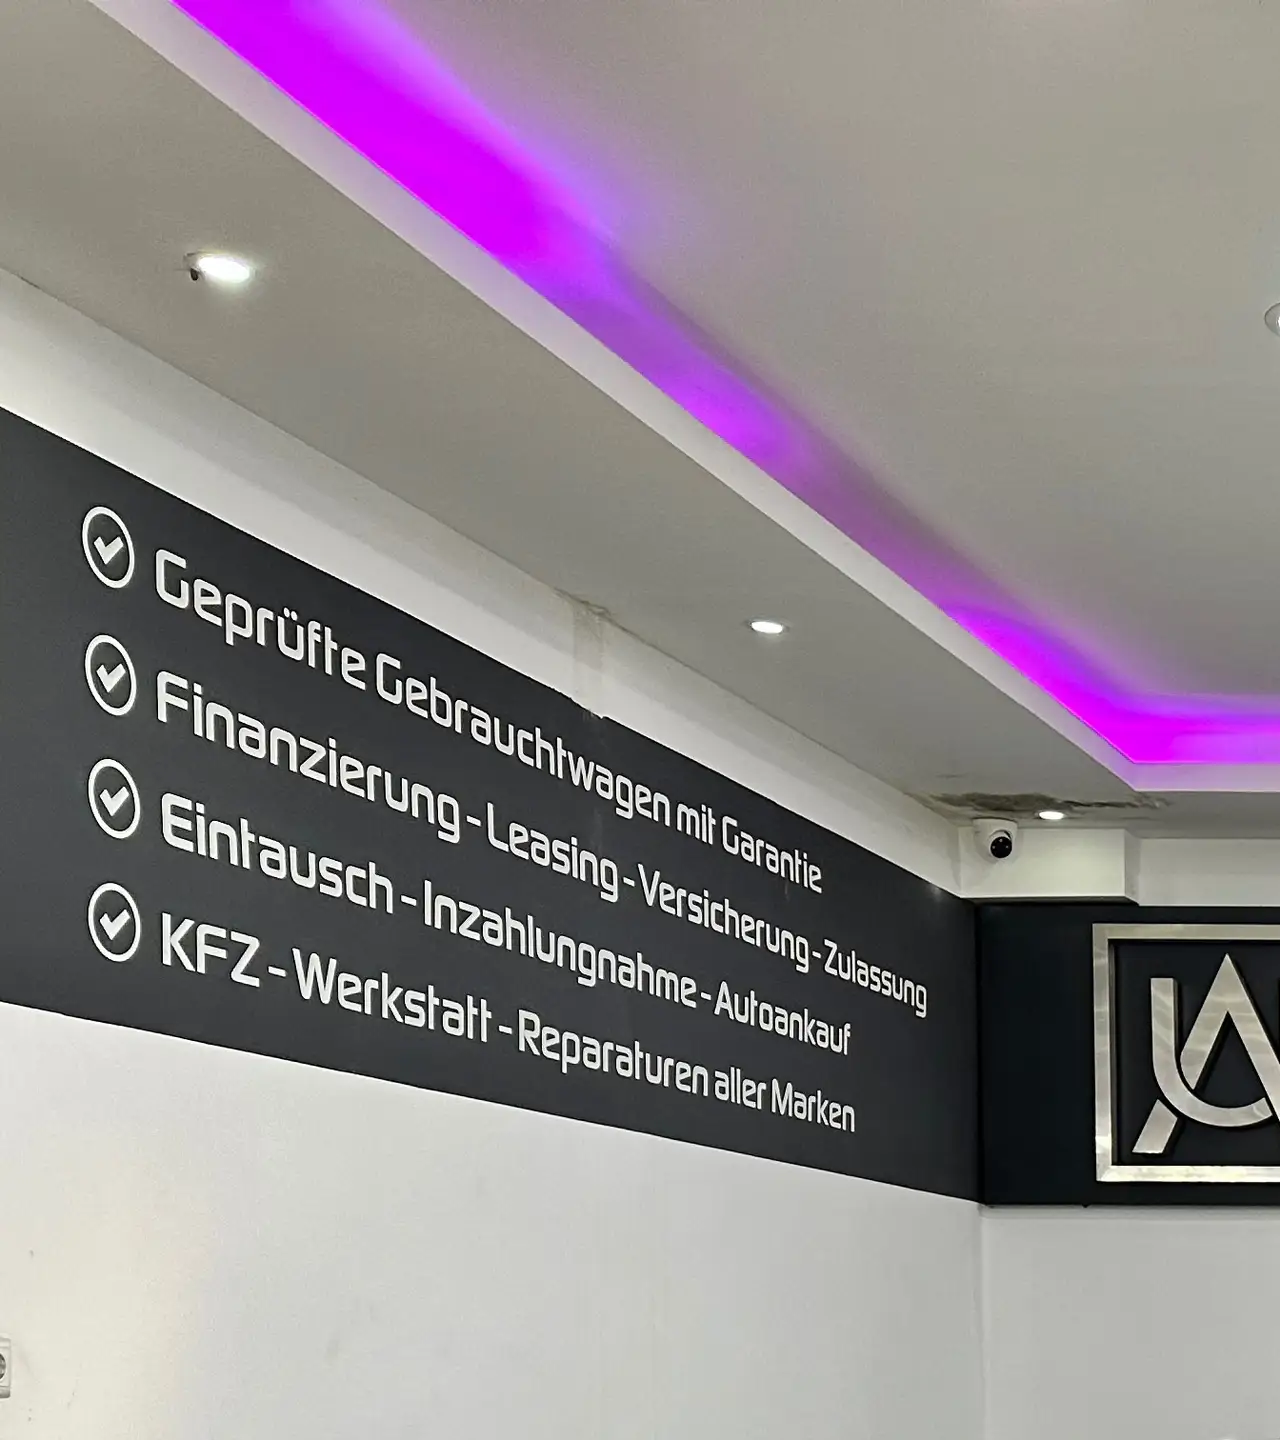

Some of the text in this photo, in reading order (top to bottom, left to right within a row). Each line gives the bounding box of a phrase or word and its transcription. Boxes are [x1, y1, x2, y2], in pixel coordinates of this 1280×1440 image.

[155, 549, 823, 894] Geprüfte Gebrauchtwagen mit Garantie
[713, 1066, 767, 1110] aller
[771, 1078, 856, 1133] Marken
